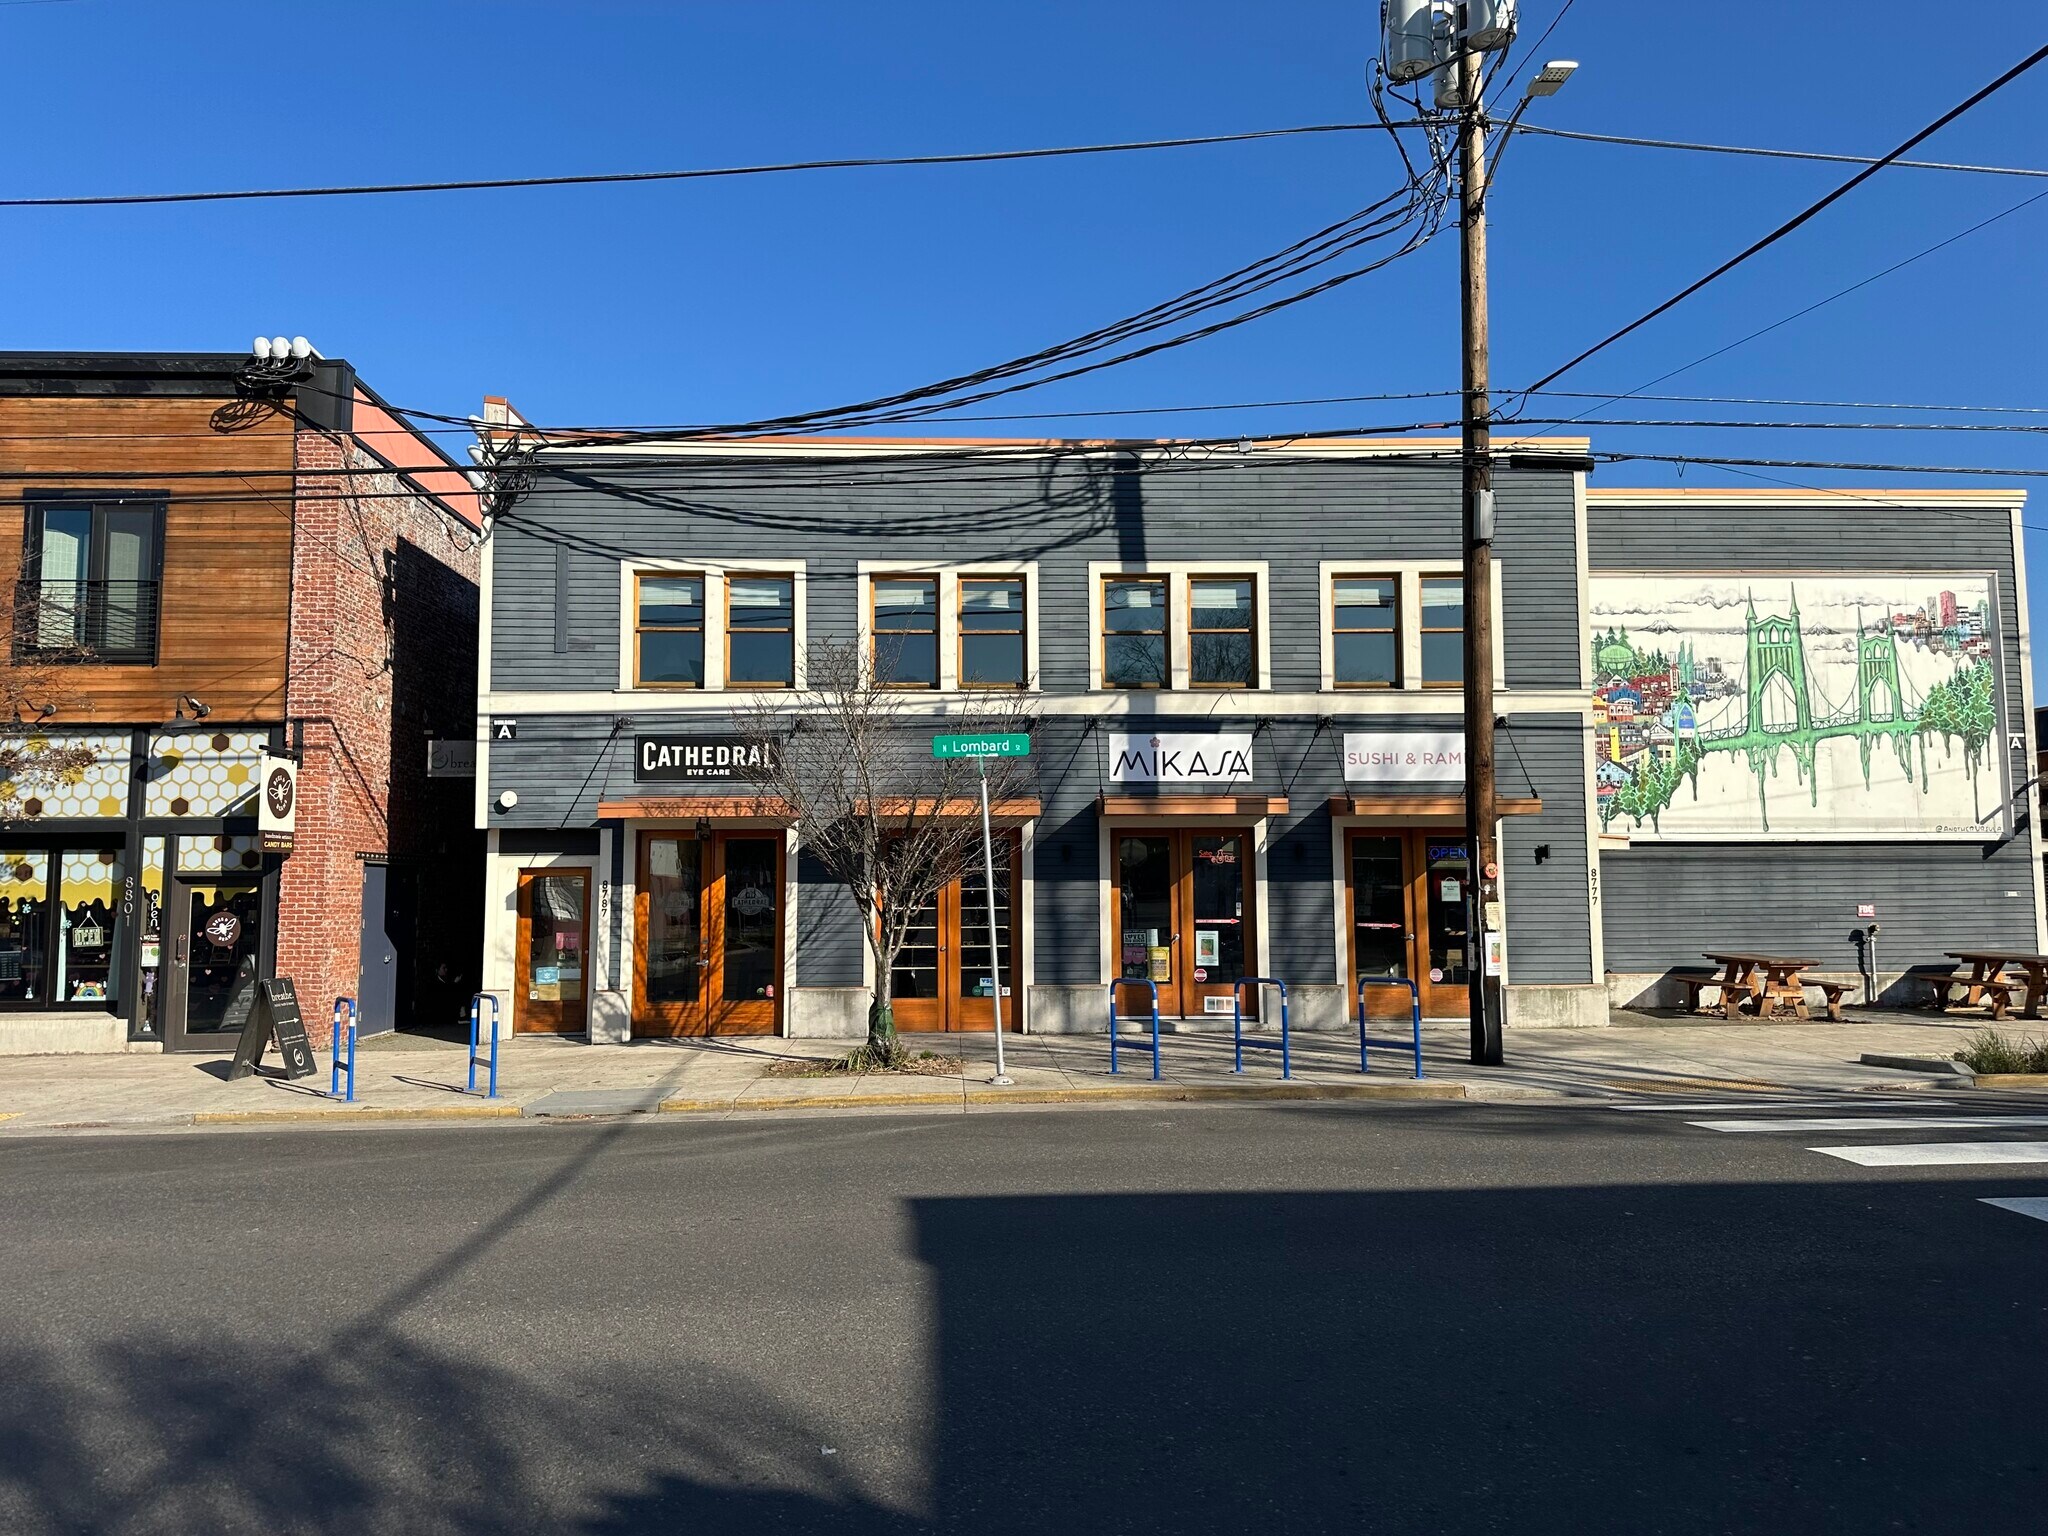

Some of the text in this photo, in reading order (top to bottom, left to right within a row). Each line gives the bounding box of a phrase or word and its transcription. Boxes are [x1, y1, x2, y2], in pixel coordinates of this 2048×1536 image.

[498, 725, 511, 738] A
[953, 740, 1009, 752] Lombard
[2010, 737, 2022, 749] A
[643, 741, 775, 771] CATHEDRAL
[1347, 752, 1462, 765] SUSHI & RAM
[1113, 750, 1250, 776] MIKASA
[1430, 848, 1467, 859] OPEN
[1590, 868, 1598, 906] 8777
[124, 876, 133, 927] 8801
[150, 893, 159, 927] open
[1858, 905, 1874, 913] FDC
[75, 932, 101, 942] OPEN
